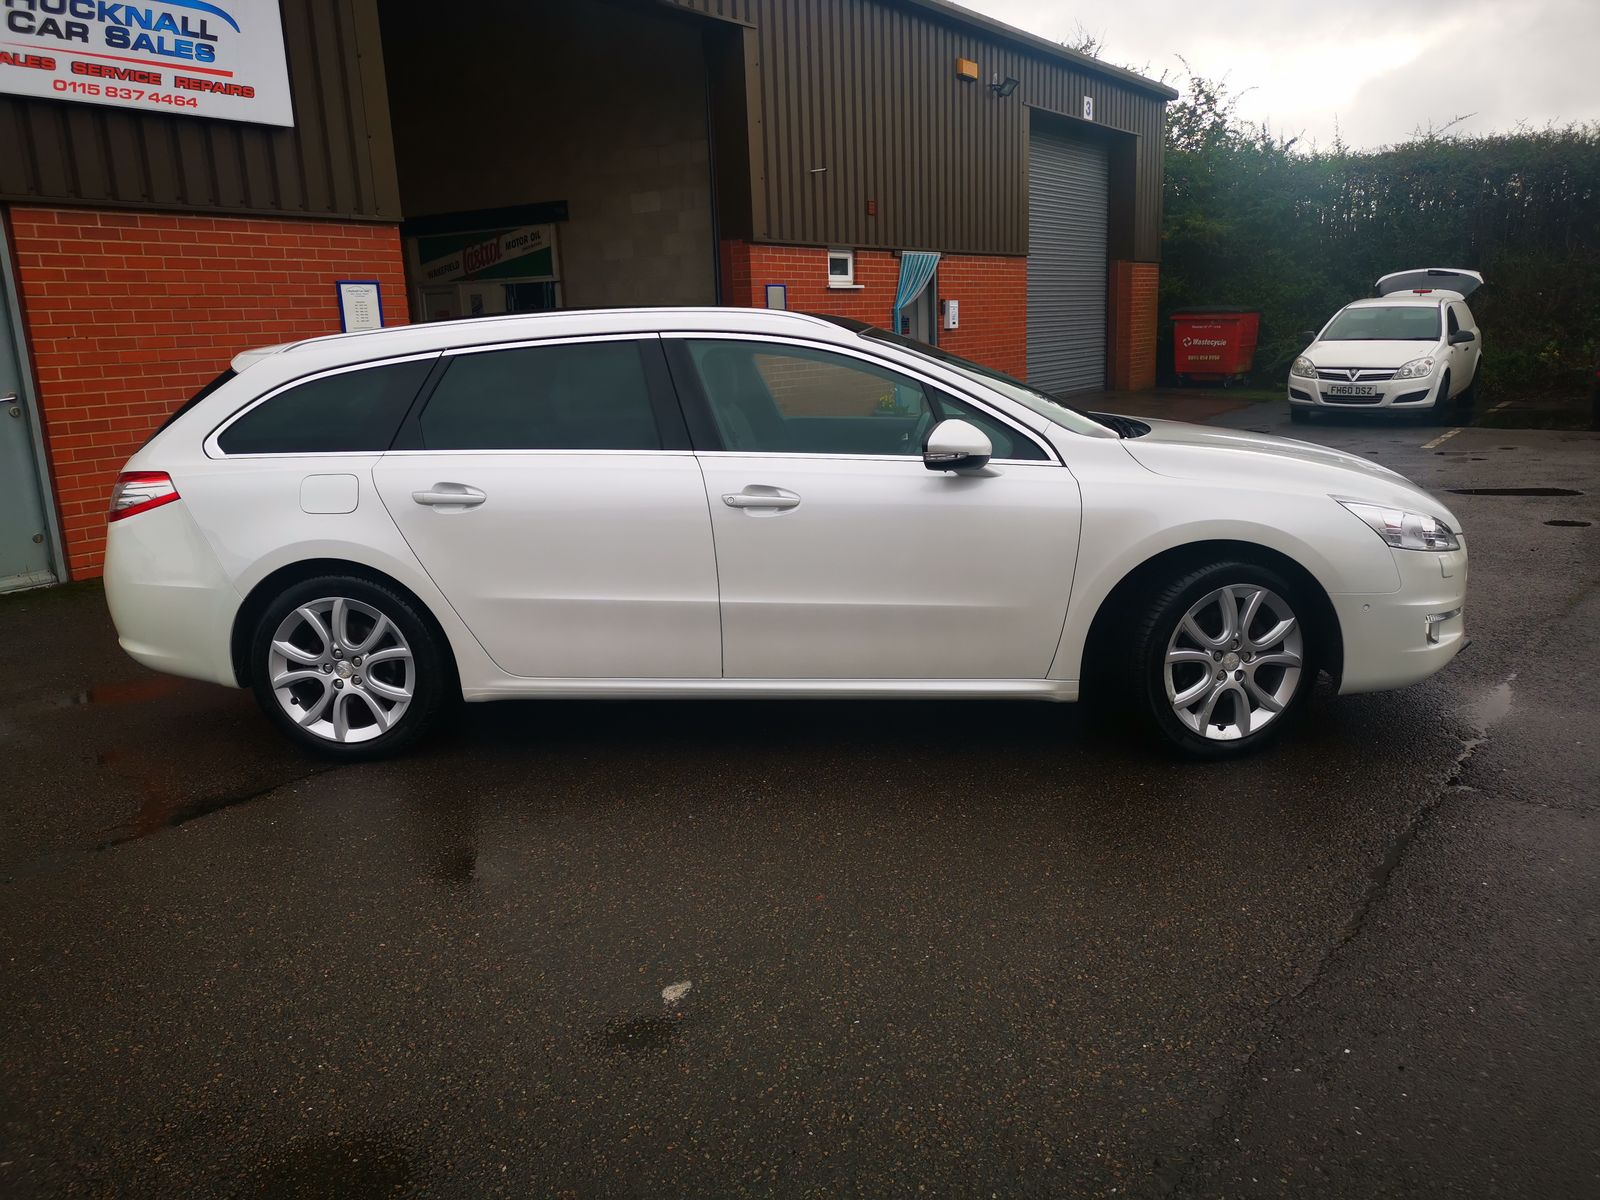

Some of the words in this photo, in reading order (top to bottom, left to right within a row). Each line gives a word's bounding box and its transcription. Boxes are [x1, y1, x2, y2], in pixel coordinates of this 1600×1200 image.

[7, 10, 89, 43] CAR
[104, 25, 216, 63] SALES
[0, 51, 56, 71] ALES
[71, 61, 162, 86] SERVICE
[174, 75, 255, 99] REPAIRS
[53, 79, 101, 96] 0115
[105, 86, 145, 101] 837
[148, 92, 198, 108] 4464
[1086, 101, 1091, 116] 3
[505, 235, 529, 251] MOTOR
[530, 230, 542, 242] OIL
[1330, 386, 1352, 394] FH60
[1354, 386, 1372, 394] DSZ
